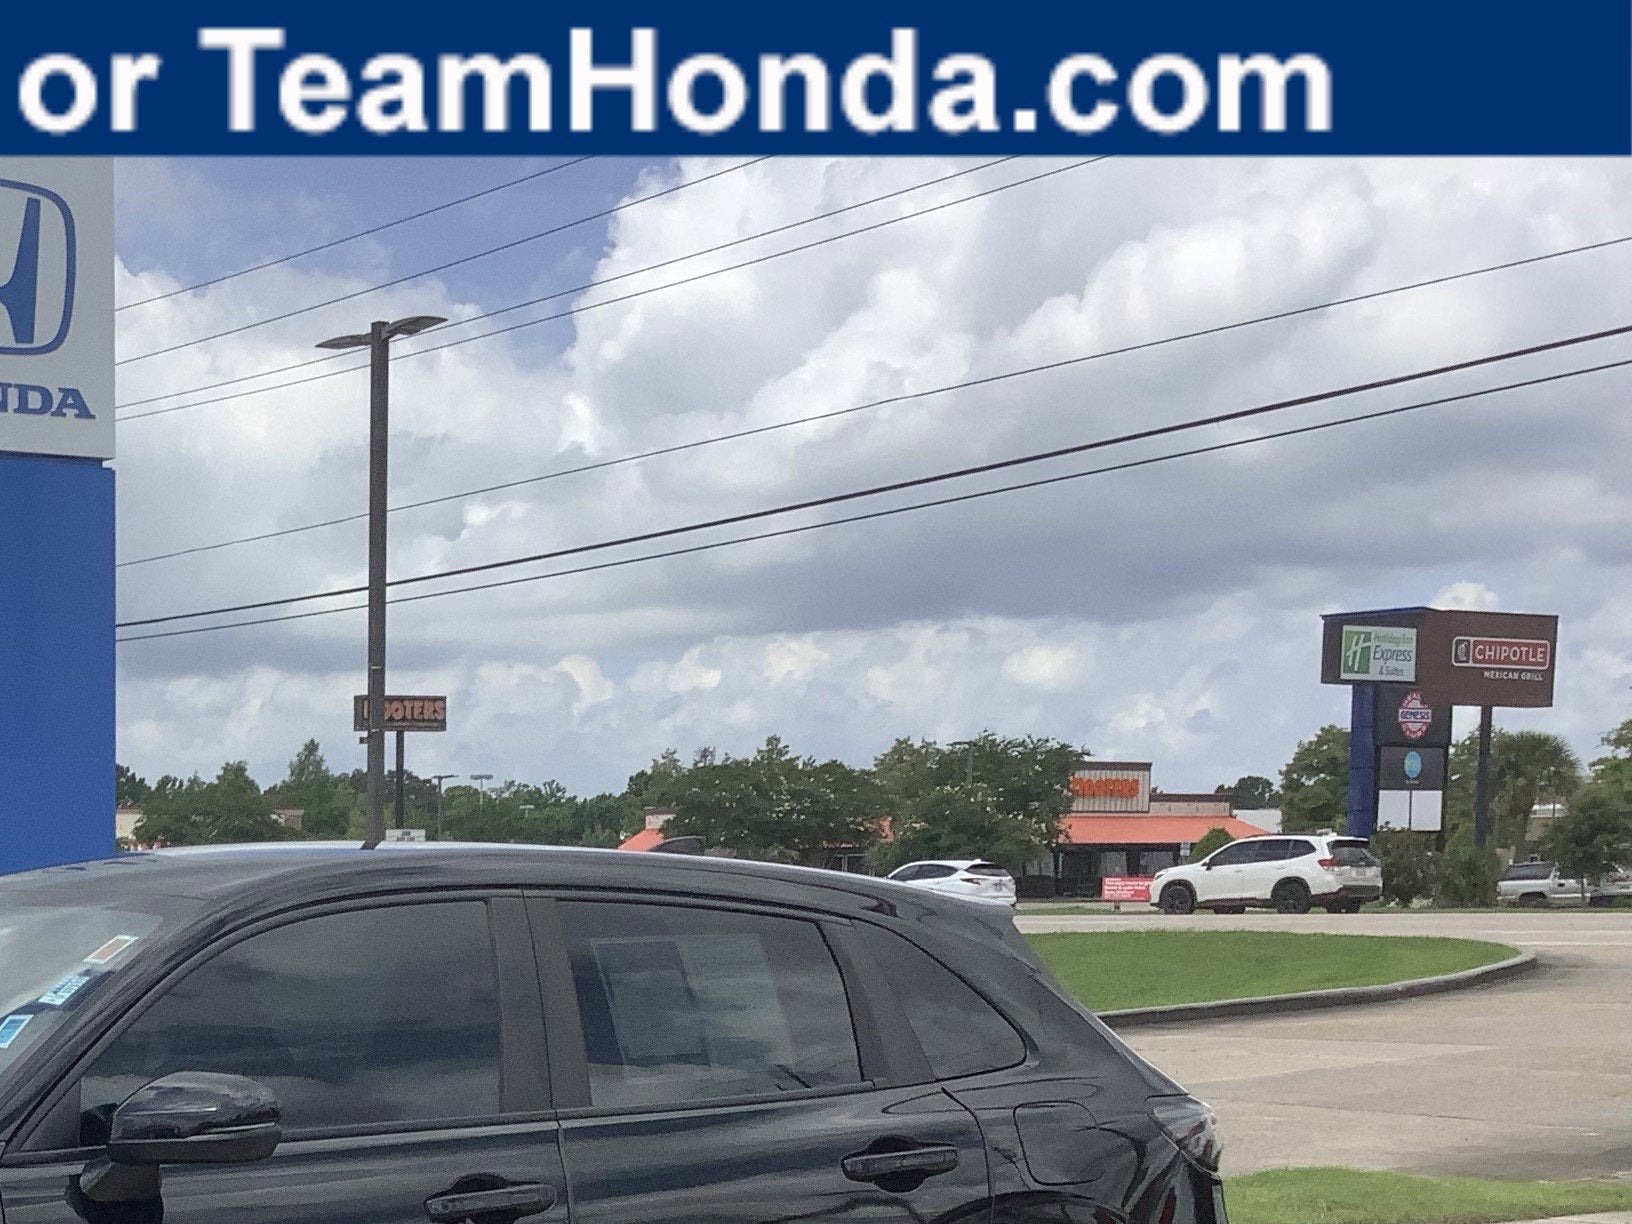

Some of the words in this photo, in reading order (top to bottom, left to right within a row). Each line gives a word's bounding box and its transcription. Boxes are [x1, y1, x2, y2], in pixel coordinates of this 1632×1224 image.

[1372, 644, 1414, 665] Express
[1474, 644, 1545, 663] CHIPOTLE
[1483, 670, 1520, 680] MEXICAN
[1520, 671, 1543, 681] GRILL
